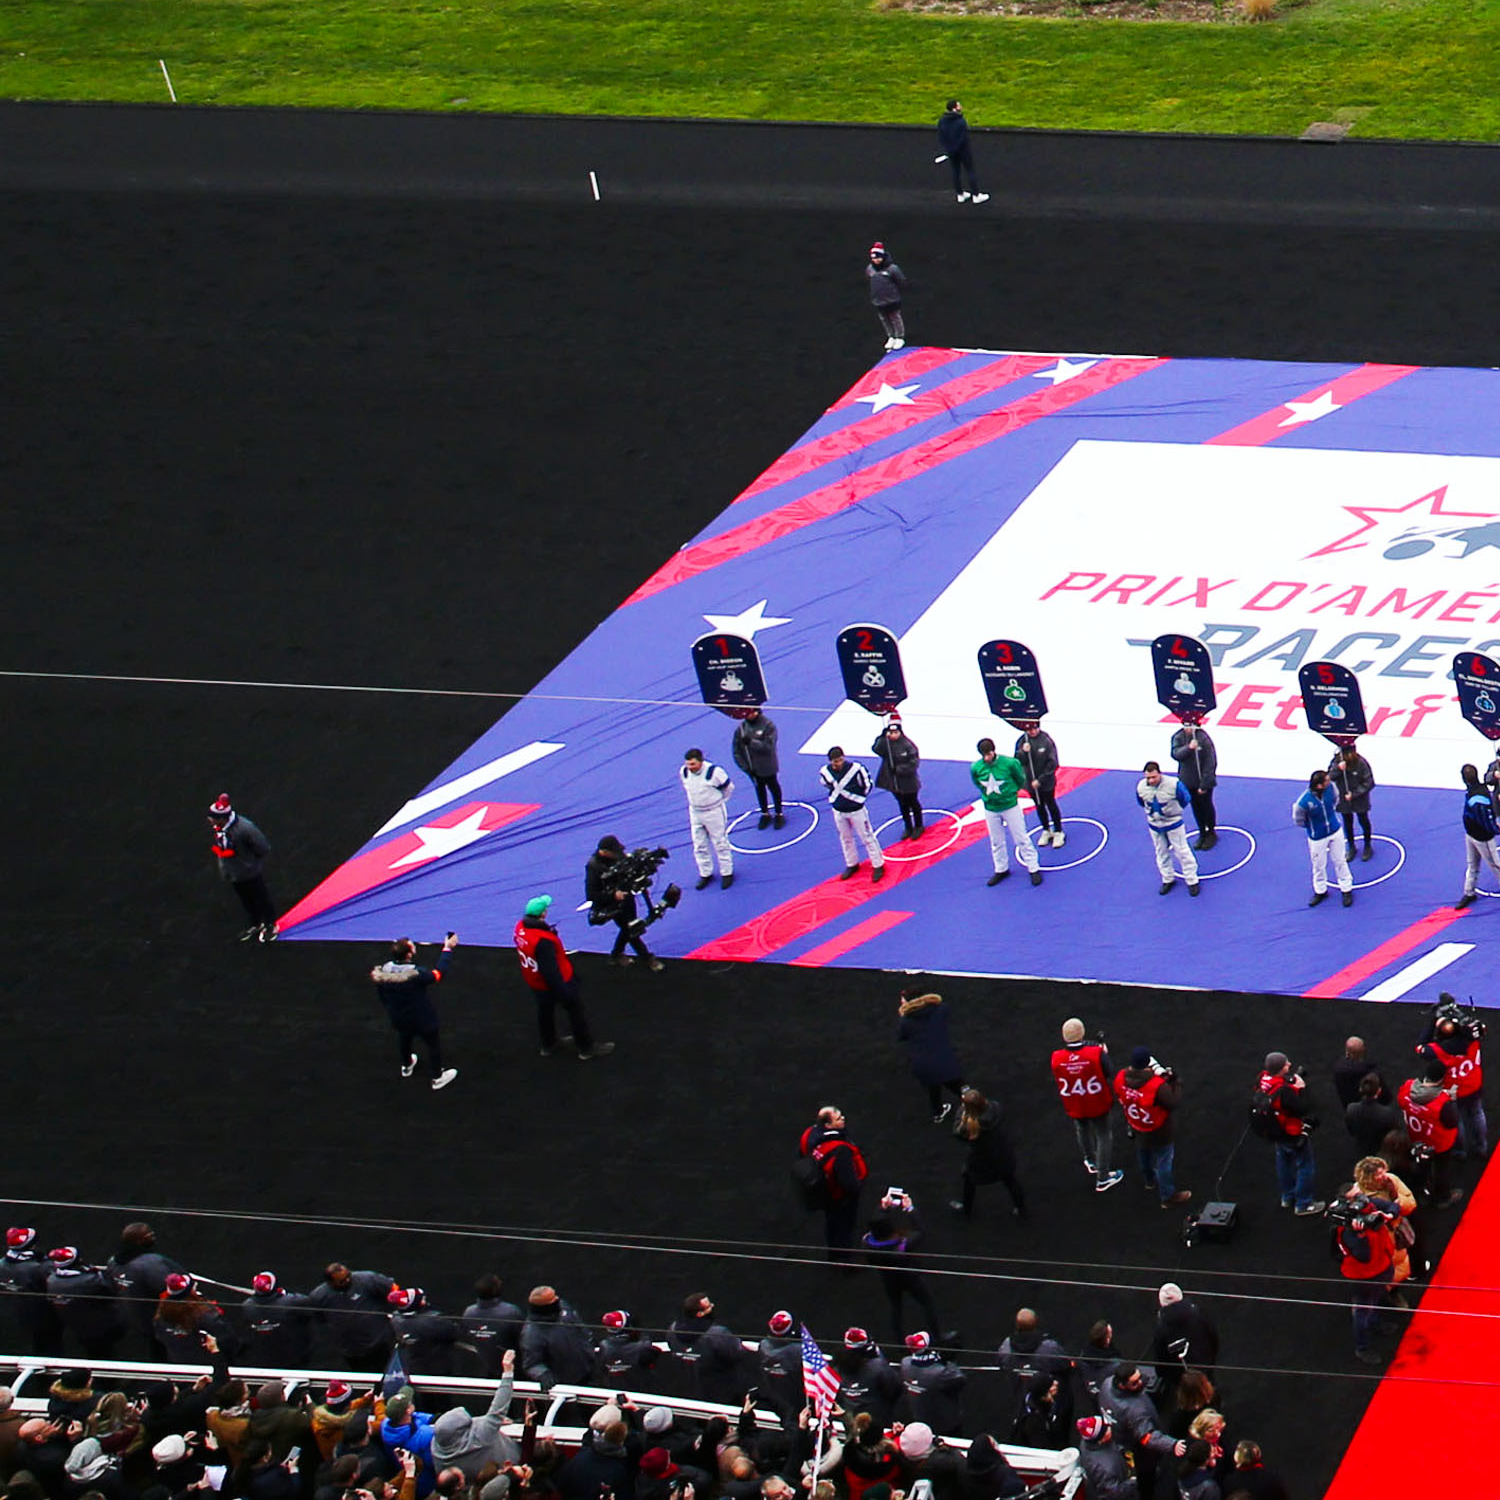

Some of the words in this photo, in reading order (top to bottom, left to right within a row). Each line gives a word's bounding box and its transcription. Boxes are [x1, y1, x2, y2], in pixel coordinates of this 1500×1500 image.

[1038, 571, 1239, 610] PRIX
[714, 637, 730, 657] 1
[856, 630, 875, 651] 2
[1171, 638, 1189, 659] 4
[995, 643, 1014, 664] 3
[1317, 664, 1336, 685] 5
[1471, 656, 1487, 676] 6
[1059, 1076, 1102, 1096] 246
